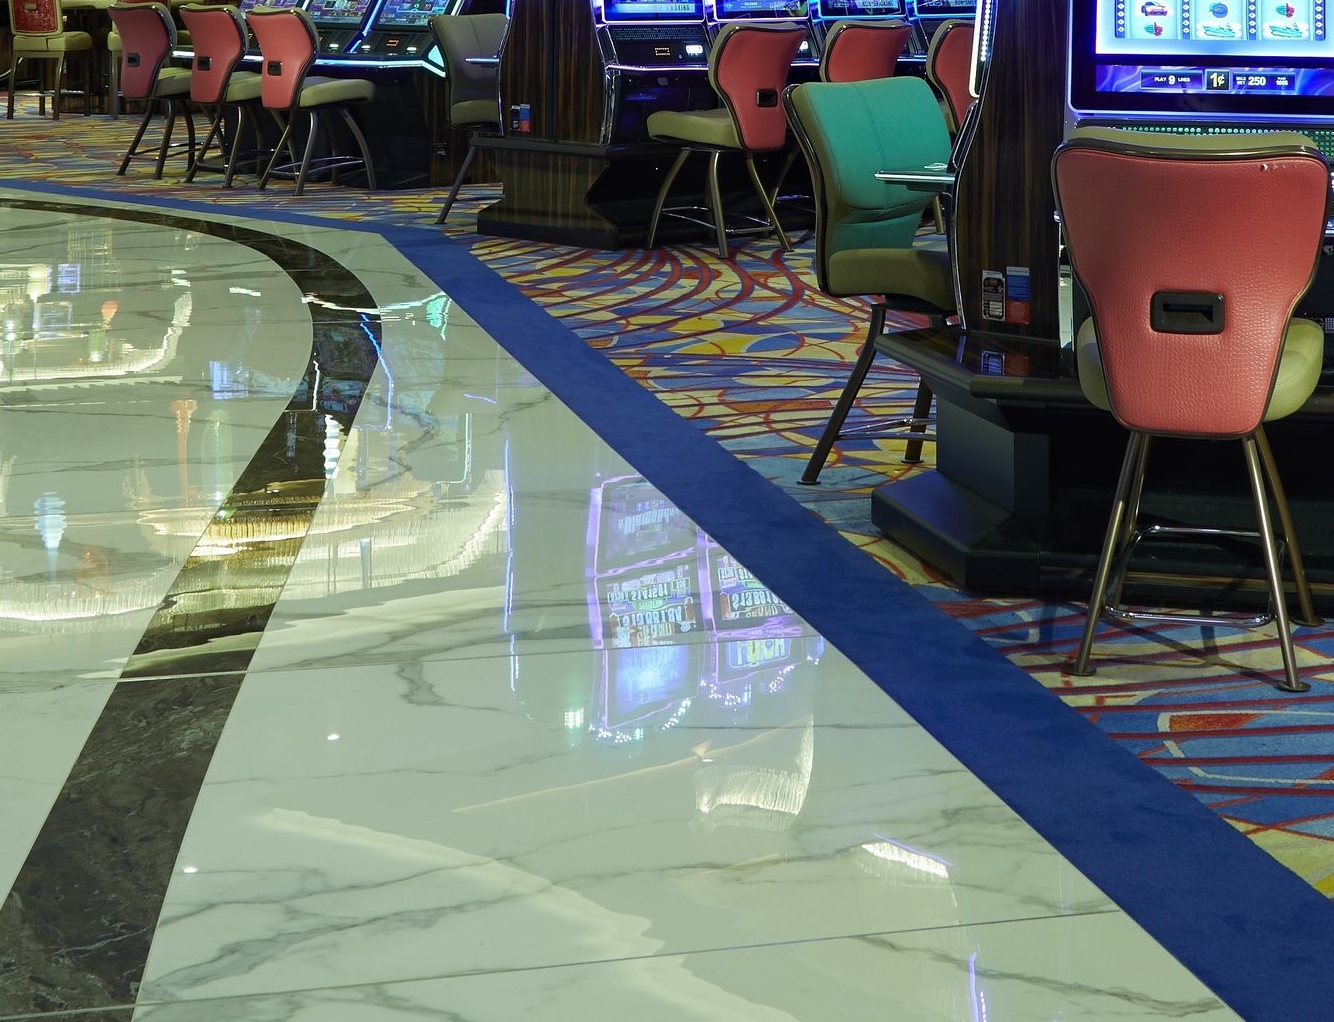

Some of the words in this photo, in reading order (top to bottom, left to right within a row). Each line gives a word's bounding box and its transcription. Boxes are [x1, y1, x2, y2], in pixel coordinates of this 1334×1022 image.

[1168, 75, 1176, 85] 9
[1210, 73, 1225, 88] 1¢
[1248, 76, 1266, 86] 250
